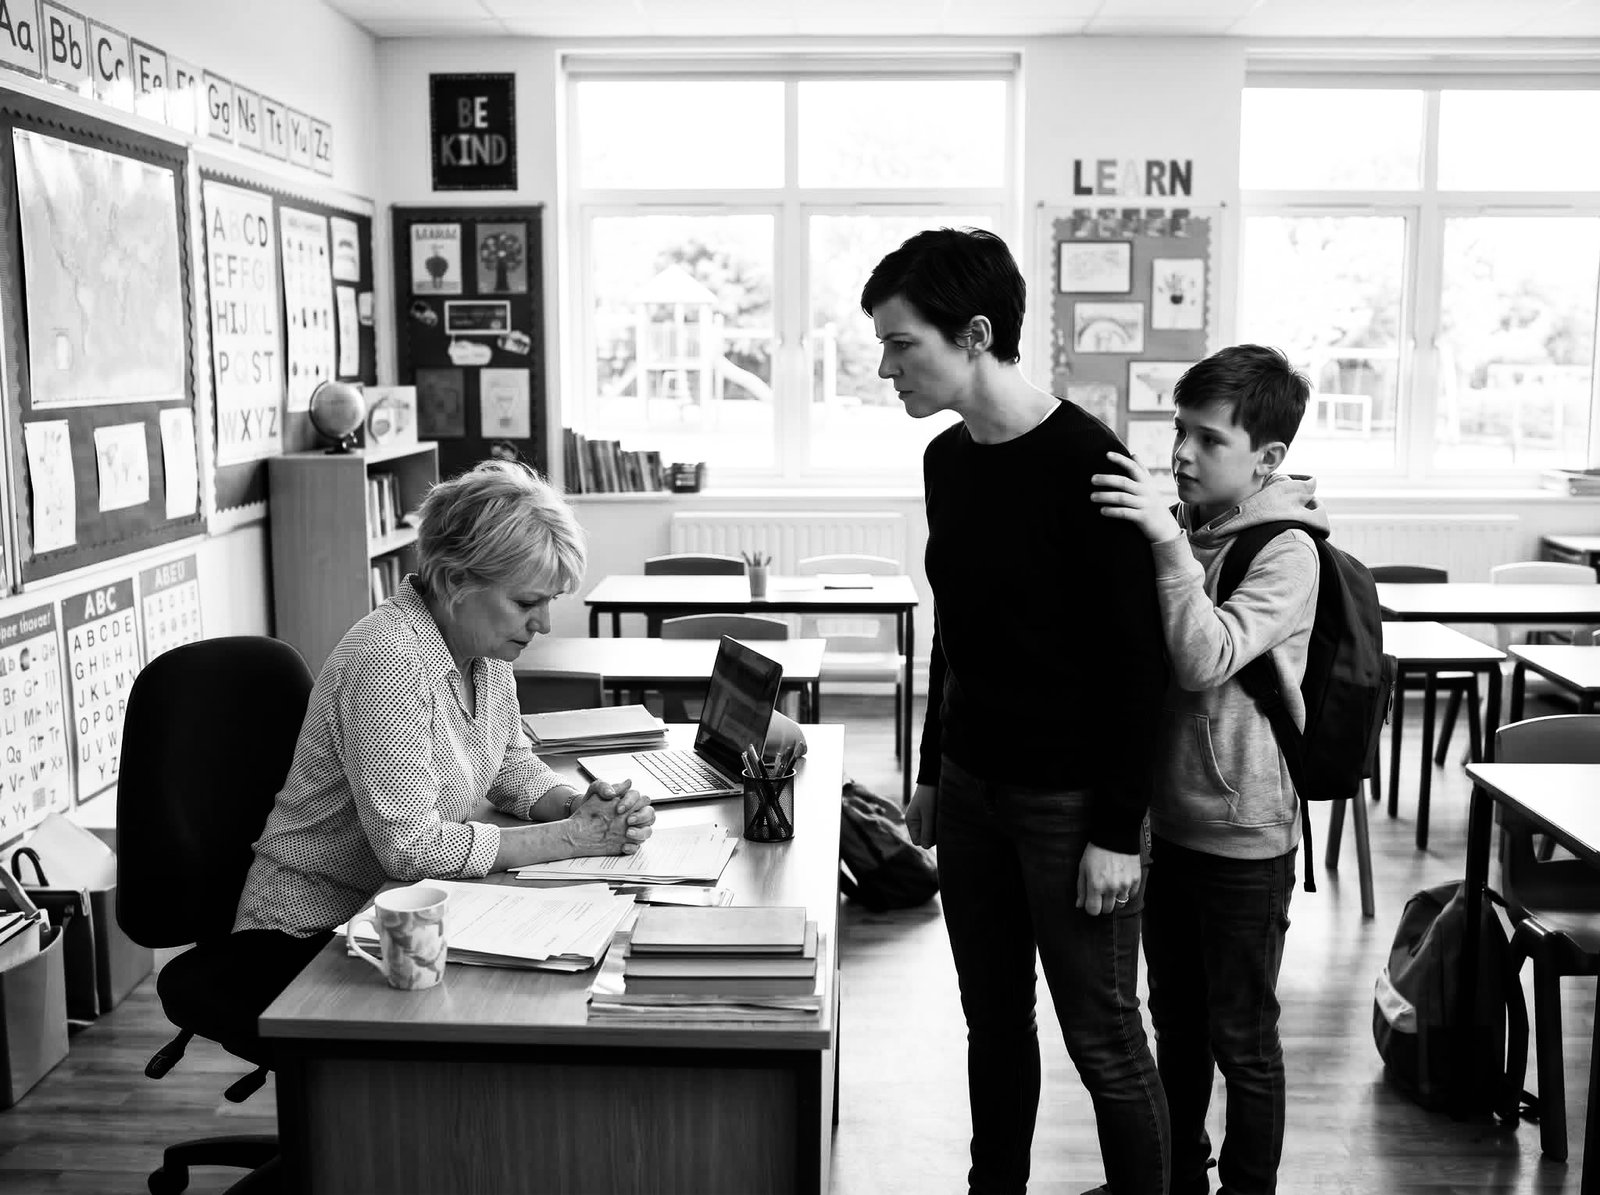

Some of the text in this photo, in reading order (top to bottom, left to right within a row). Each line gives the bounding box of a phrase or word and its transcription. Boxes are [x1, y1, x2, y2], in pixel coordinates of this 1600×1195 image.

[0, 0, 34, 53] Aa
[50, 15, 82, 70] Bb
[208, 83, 230, 134] Gg
[238, 95, 256, 135] Ns
[267, 107, 283, 145] Tt
[314, 128, 330, 161] Zz
[458, 96, 489, 128] BE
[441, 133, 507, 165] KIND
[1073, 159, 1193, 196] LEARN
[84, 586, 117, 620] ABC
